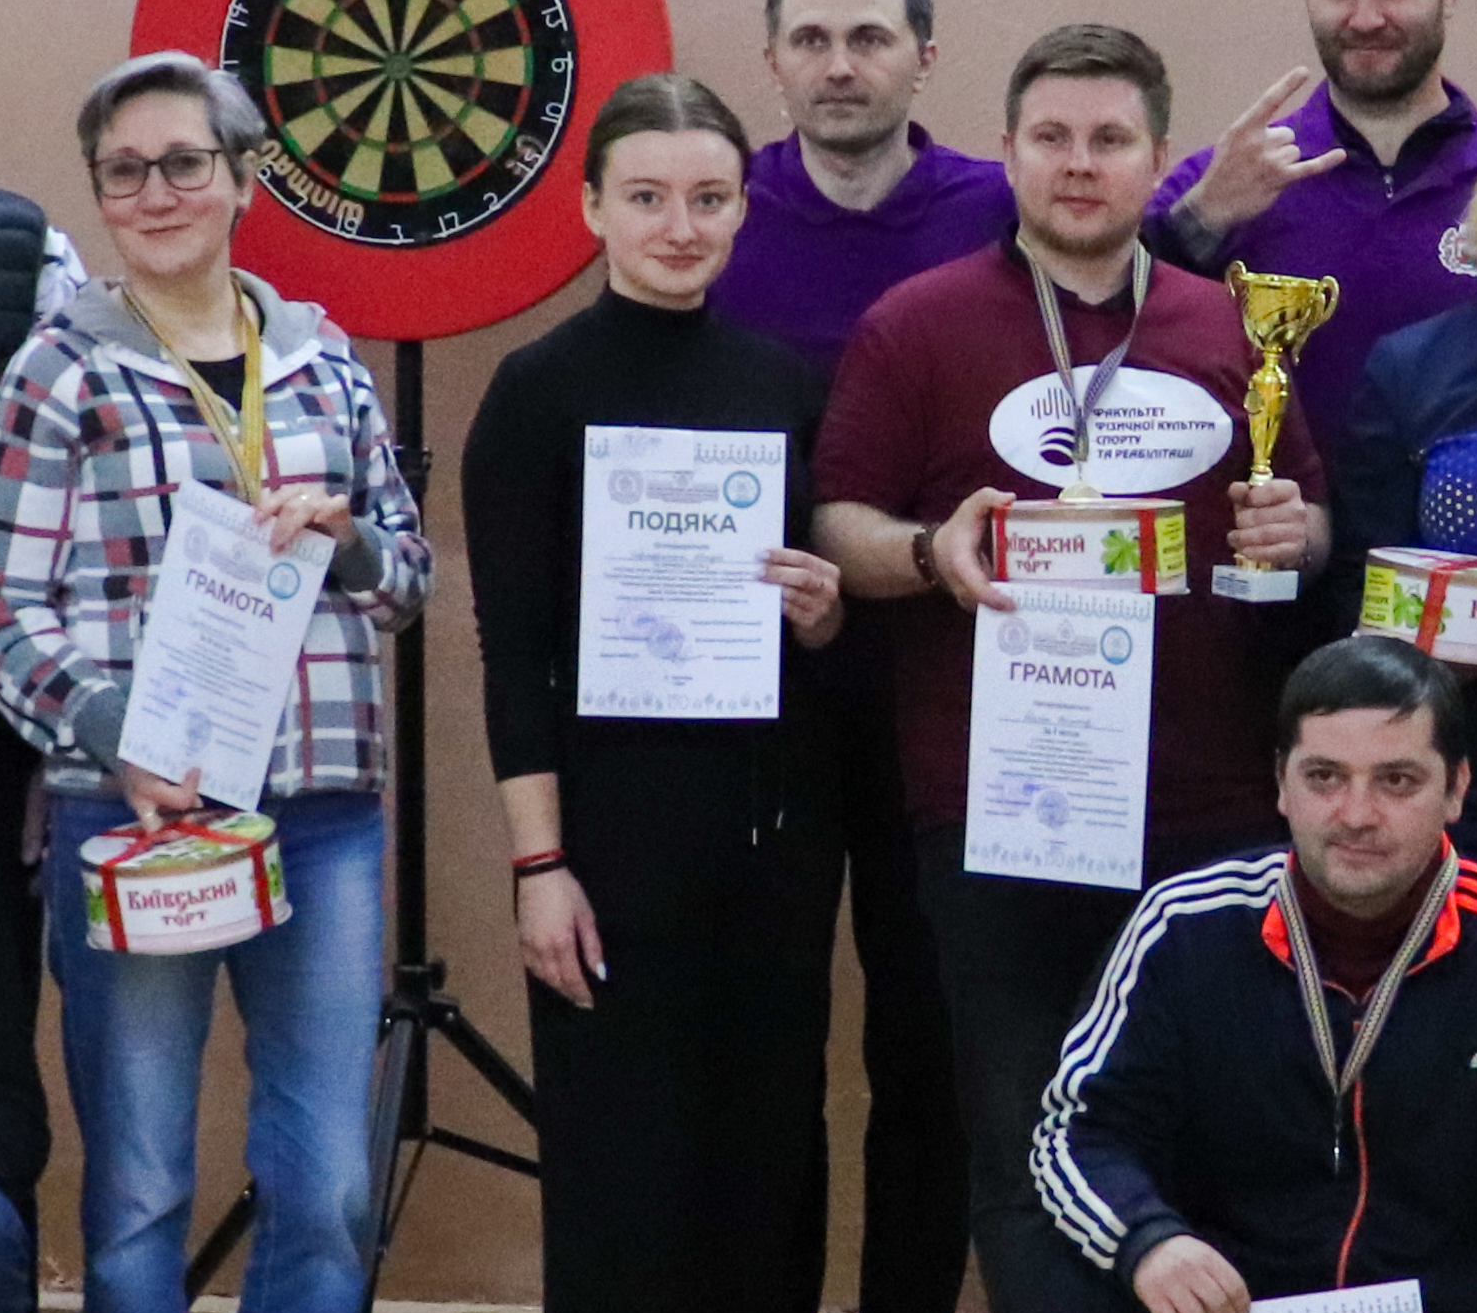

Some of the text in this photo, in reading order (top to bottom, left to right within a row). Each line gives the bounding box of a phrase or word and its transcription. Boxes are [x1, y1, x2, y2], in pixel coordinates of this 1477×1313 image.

[1094, 406, 1166, 418] ФАКУЛЬТЕТ
[1095, 419, 1155, 432] ФІЗИЧНОЇ
[1096, 435, 1142, 446] СПОРТУ
[1097, 448, 1112, 460] ТА
[628, 510, 737, 535] ПОДЯКА
[1007, 532, 1085, 559] ївський
[185, 568, 274, 623] ГРАМОТА
[1009, 661, 1117, 690] ГРАМОТА
[126, 877, 238, 913] Київський
